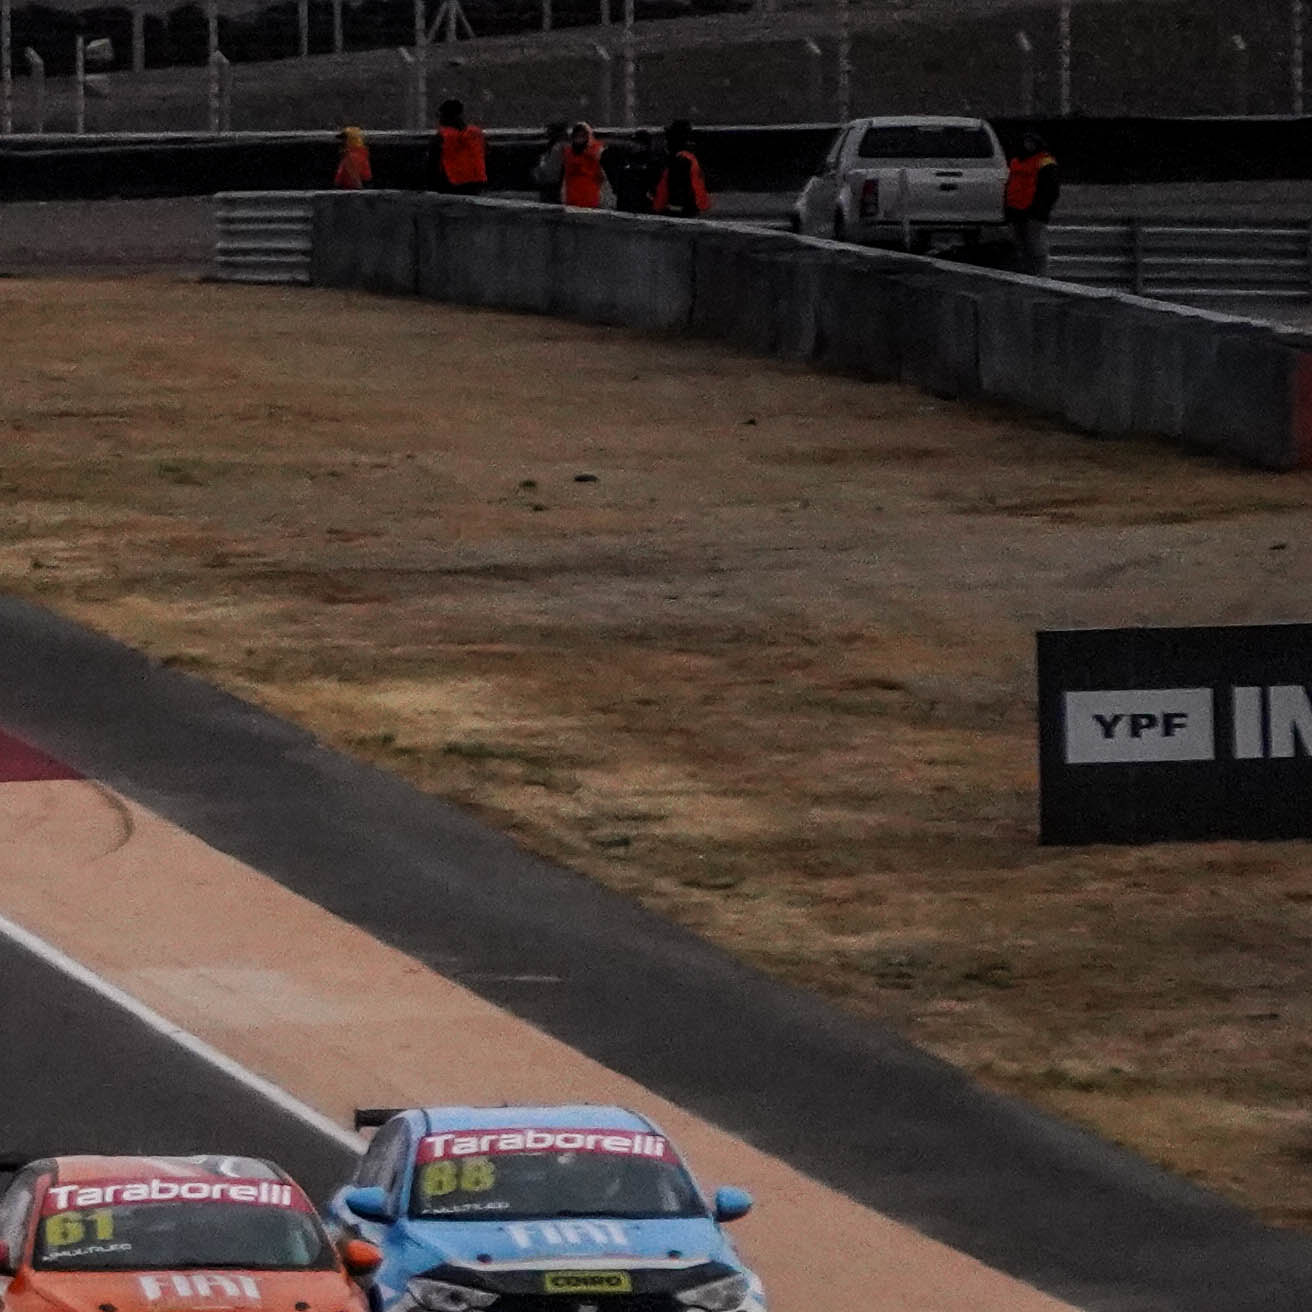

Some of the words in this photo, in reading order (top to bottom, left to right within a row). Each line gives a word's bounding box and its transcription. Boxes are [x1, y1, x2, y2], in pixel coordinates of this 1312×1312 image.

[1093, 712, 1188, 739] YPF
[424, 1128, 667, 1159] Taraborelli
[48, 1178, 293, 1210] Taraborelli
[45, 1208, 115, 1247] 61
[138, 1274, 264, 1301] FIAT
